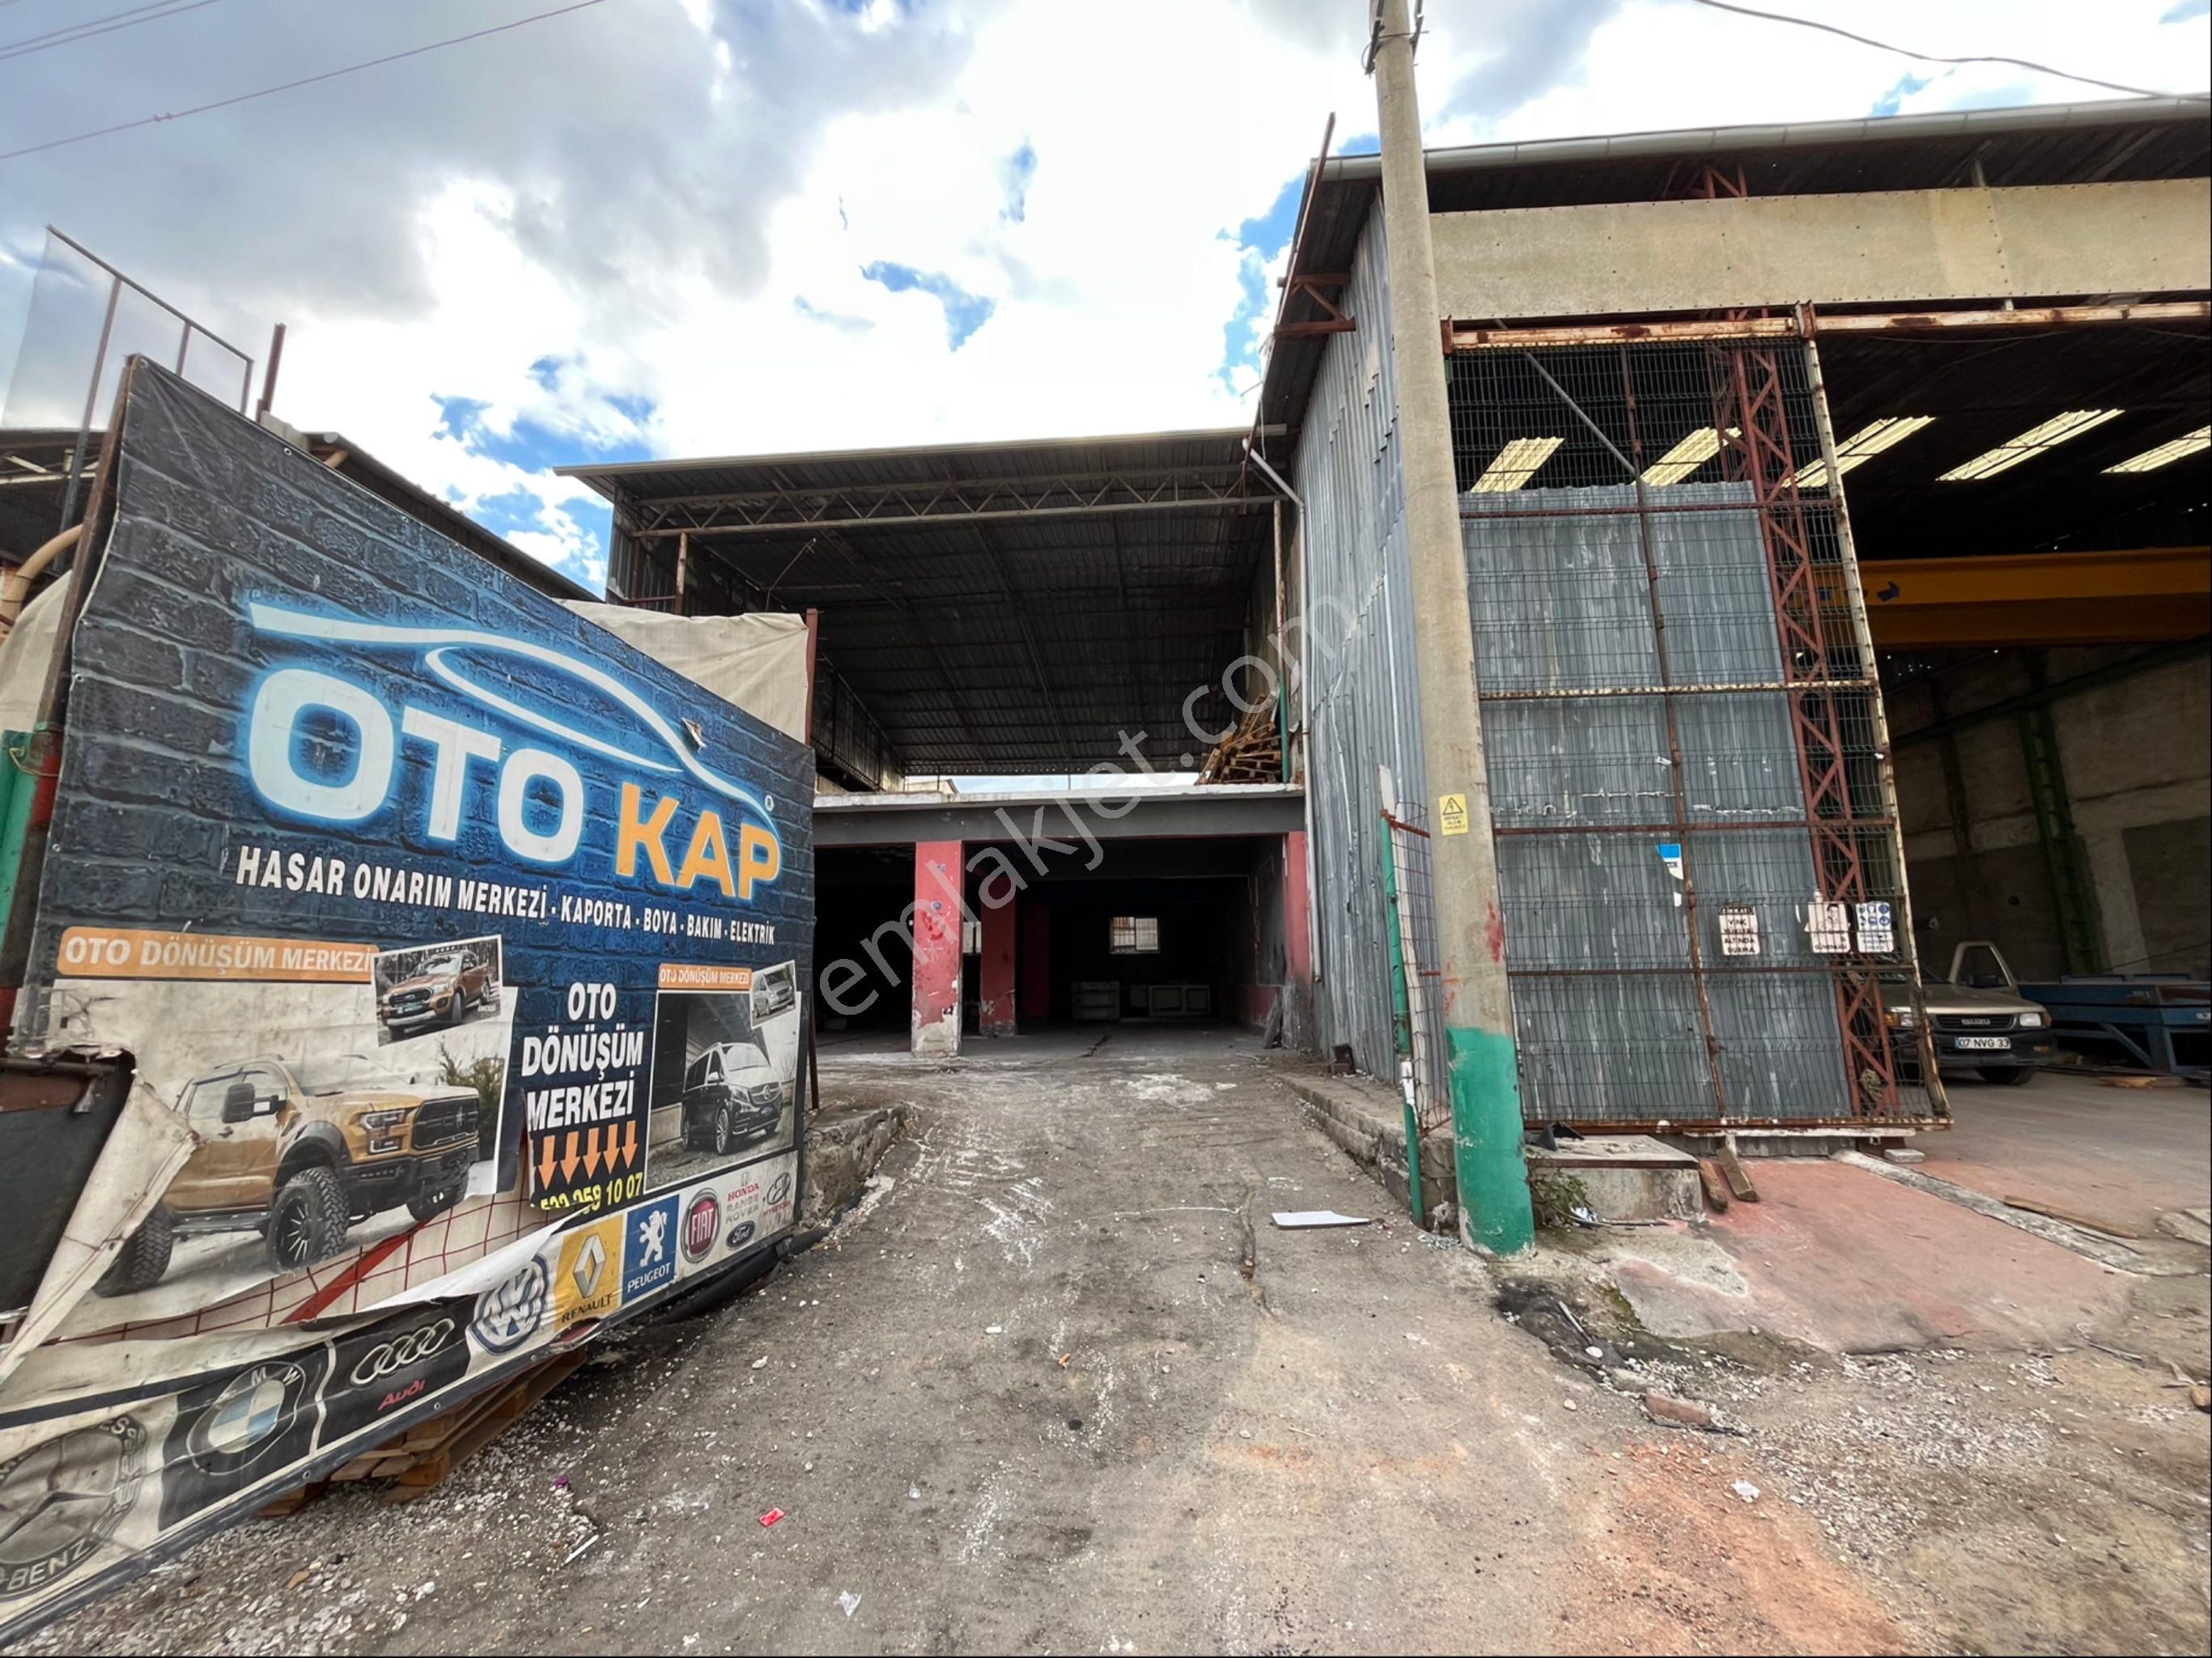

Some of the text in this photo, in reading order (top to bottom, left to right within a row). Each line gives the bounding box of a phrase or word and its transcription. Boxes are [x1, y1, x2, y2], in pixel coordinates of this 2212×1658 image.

[248, 668, 783, 901] OTO KAP
[235, 845, 775, 946] HASAR ONARIM MERKEZİ KAPORTA BOYA BAKIM ELEKTRİK
[65, 935, 131, 965] OTO
[139, 935, 276, 975] DÖNÜŞÜM
[567, 981, 618, 1022] OTO
[521, 1024, 644, 1081] DÖNÜŞÜM
[526, 1070, 635, 1133] MERKEZİ
[606, 1177, 623, 1206] 10
[626, 1171, 643, 1200] 07
[728, 1182, 760, 1202] HONDA
[690, 1207, 715, 1246] FIAT
[731, 1224, 751, 1245] Ford
[626, 1262, 672, 1293] PEUGEOT
[561, 1292, 614, 1324] RENAULT
